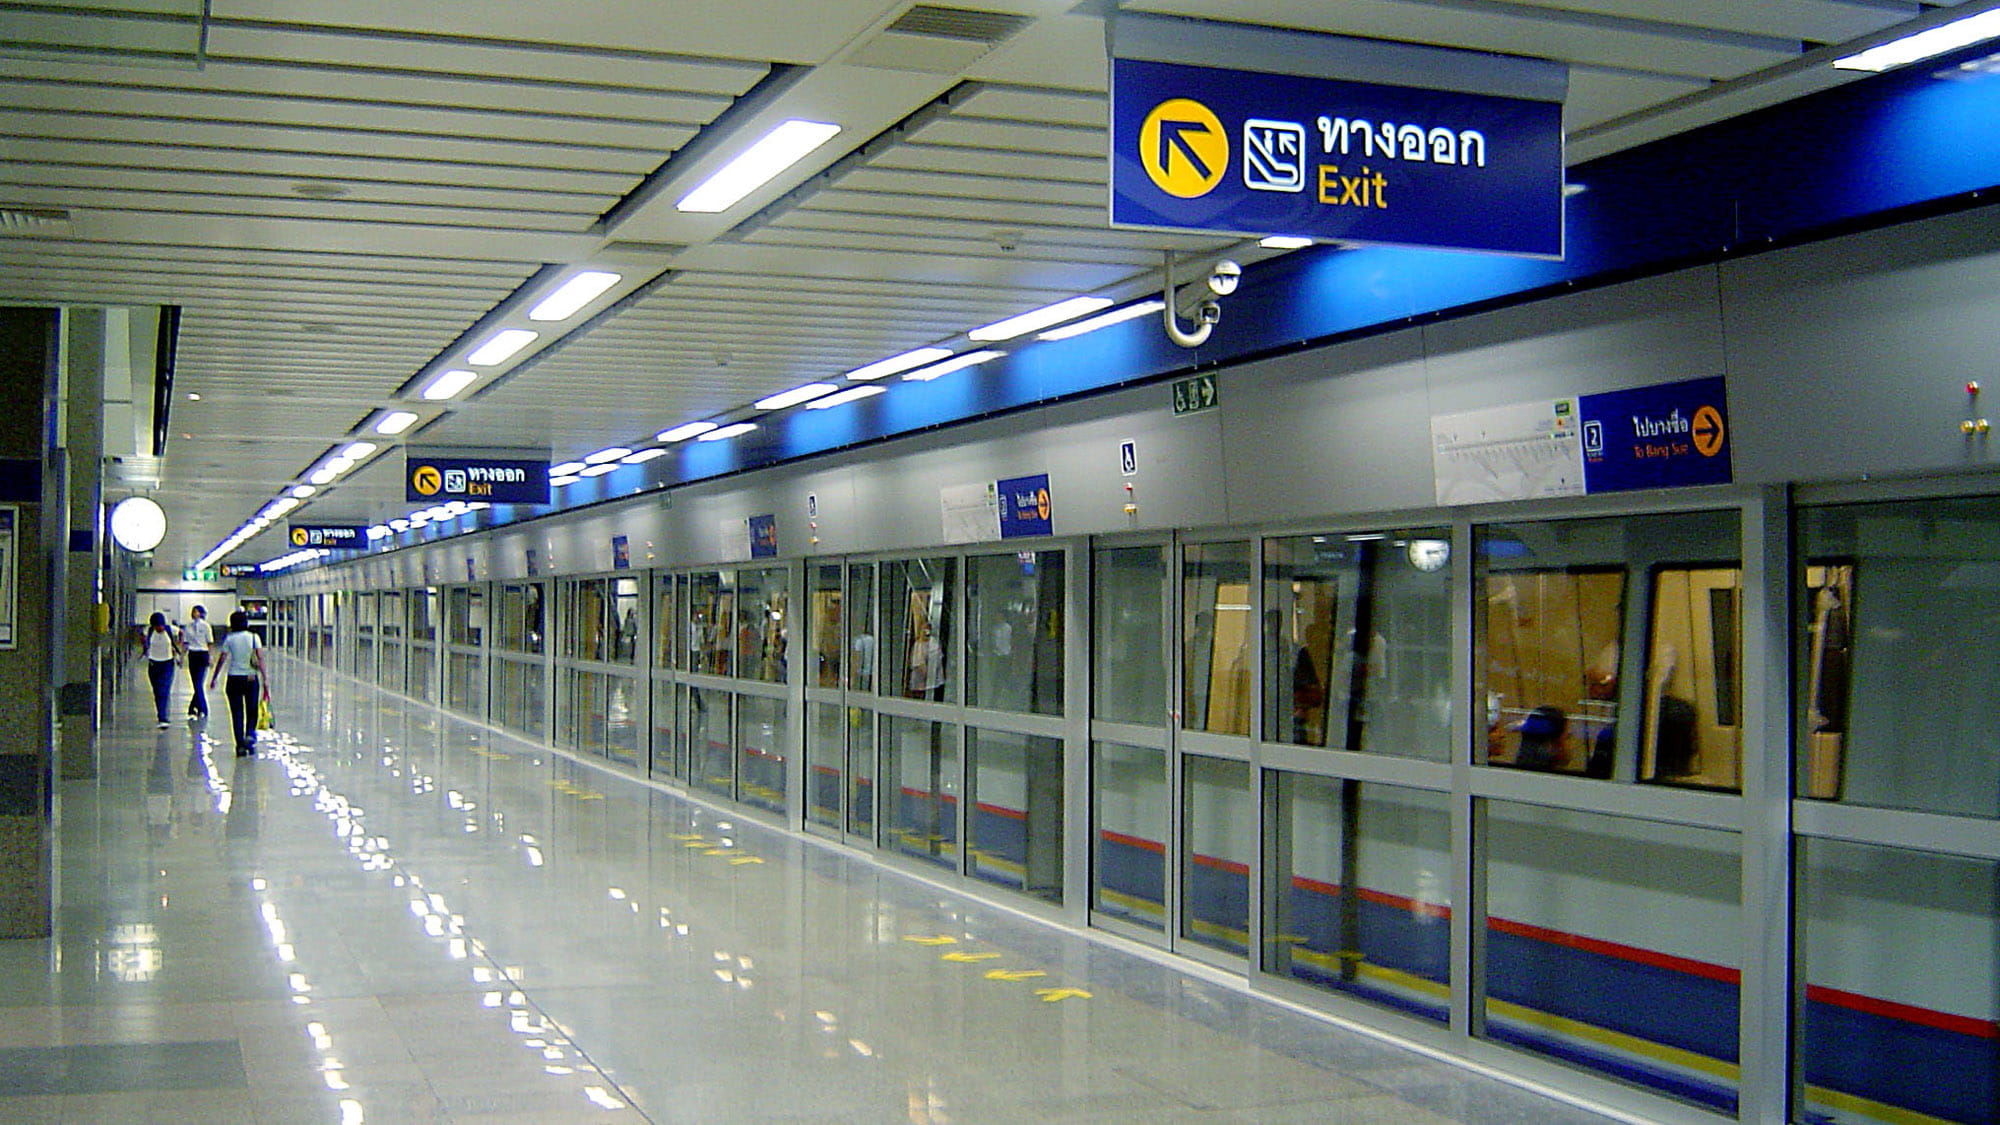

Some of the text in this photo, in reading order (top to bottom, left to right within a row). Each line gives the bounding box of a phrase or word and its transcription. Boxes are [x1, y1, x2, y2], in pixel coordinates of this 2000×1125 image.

[1317, 116, 1486, 168] ทางออก
[1318, 164, 1387, 209] Exit
[1590, 428, 1598, 446] 2
[469, 482, 492, 496] Exit
